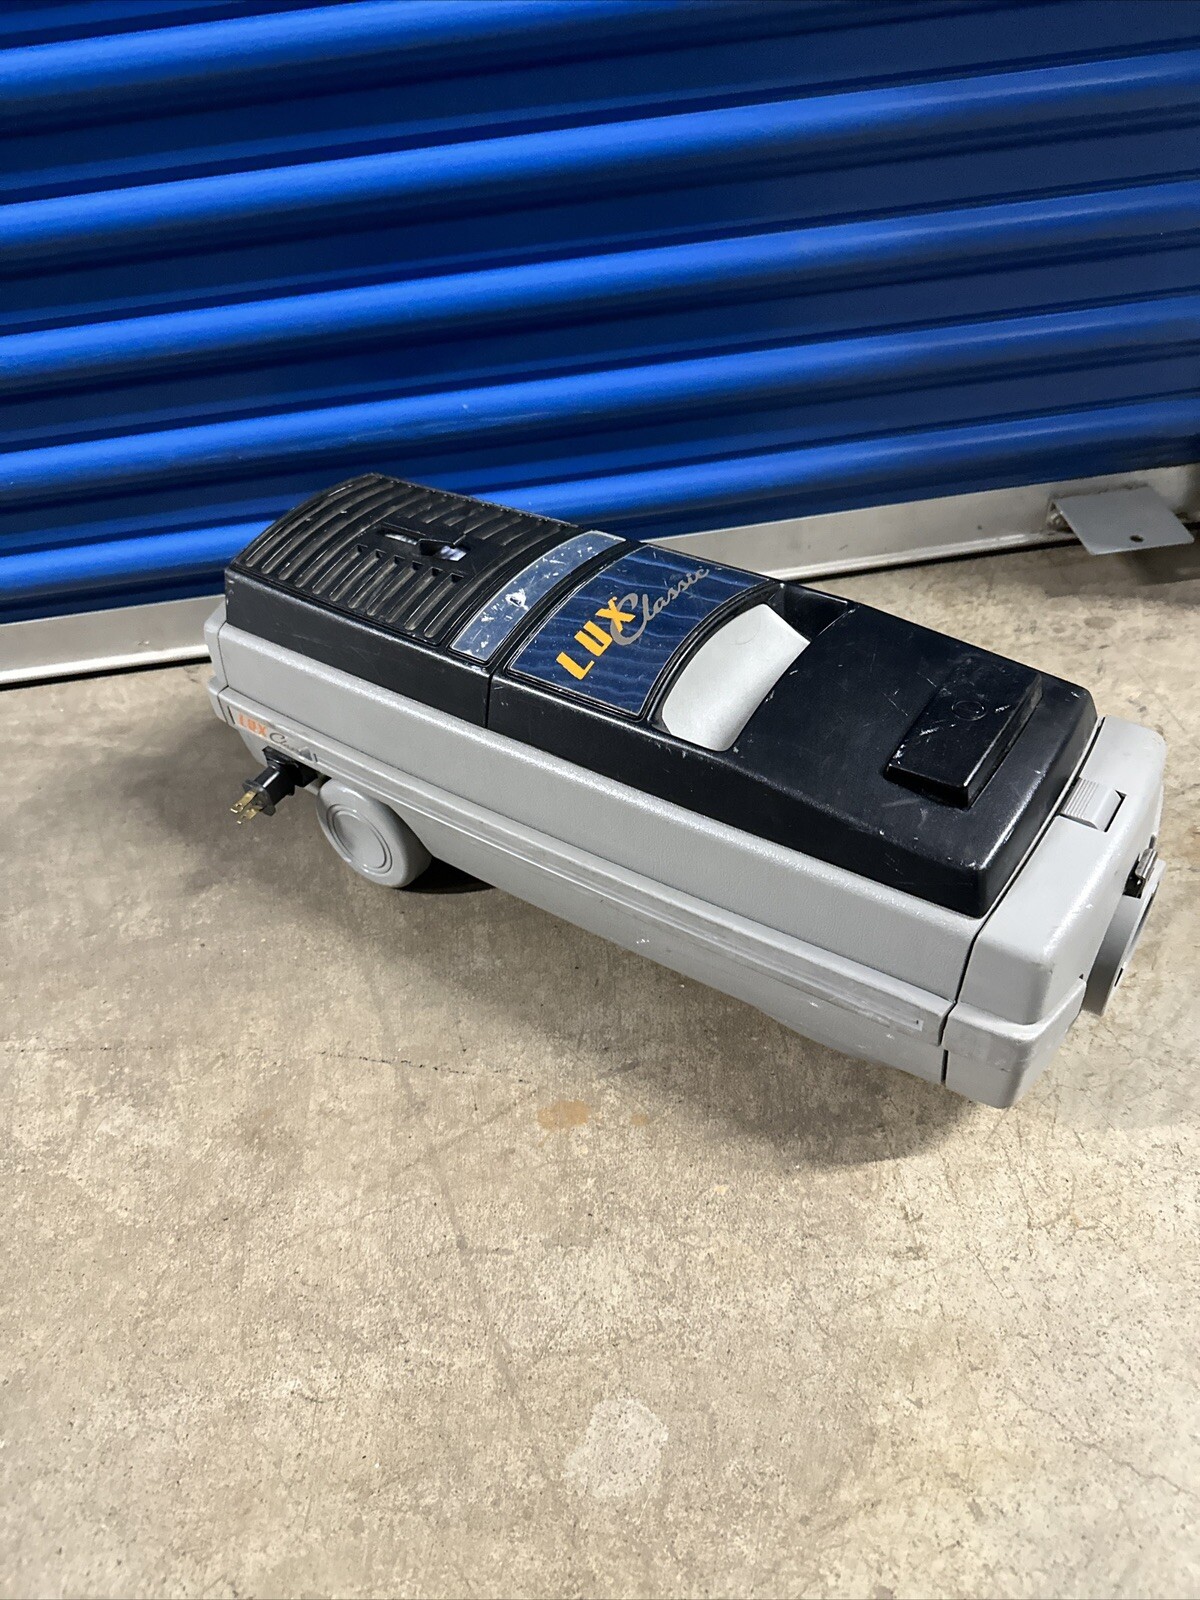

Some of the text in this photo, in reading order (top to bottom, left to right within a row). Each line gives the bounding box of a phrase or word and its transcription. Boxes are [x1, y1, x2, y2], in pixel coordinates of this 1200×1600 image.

[556, 565, 710, 680] LUX Classic
[238, 712, 268, 737] LUX
